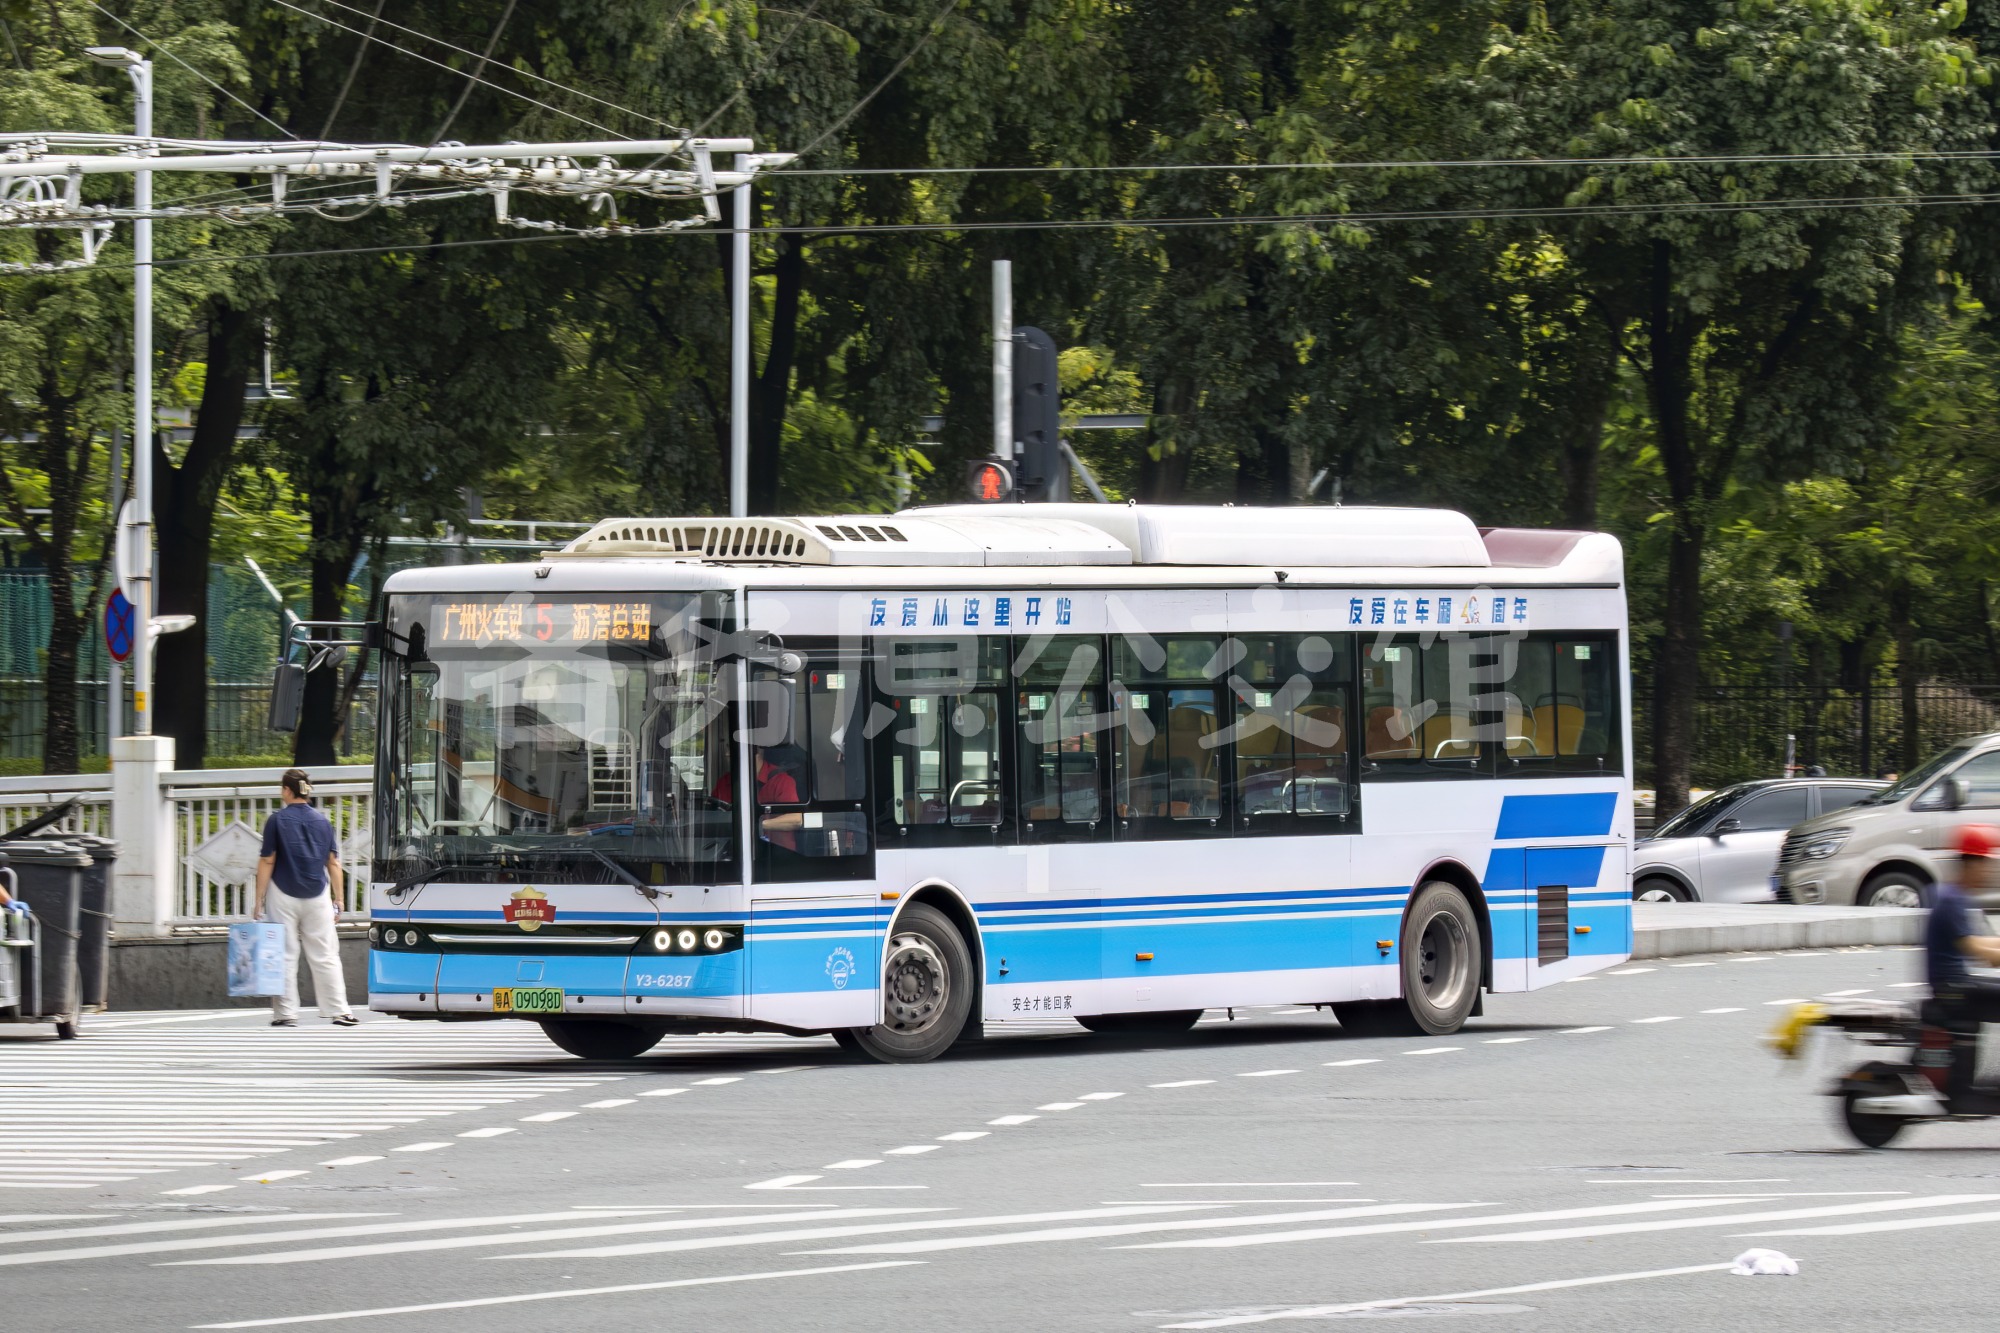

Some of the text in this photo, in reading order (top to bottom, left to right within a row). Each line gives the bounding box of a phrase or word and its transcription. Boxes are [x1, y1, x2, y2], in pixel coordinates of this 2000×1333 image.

[442, 603, 650, 640] 广州火车站 5 沥滘总站
[870, 597, 1072, 627] 友爱从这里开始
[635, 974, 692, 988] Y3-6287
[1012, 995, 1073, 1012] 安全才能回家
